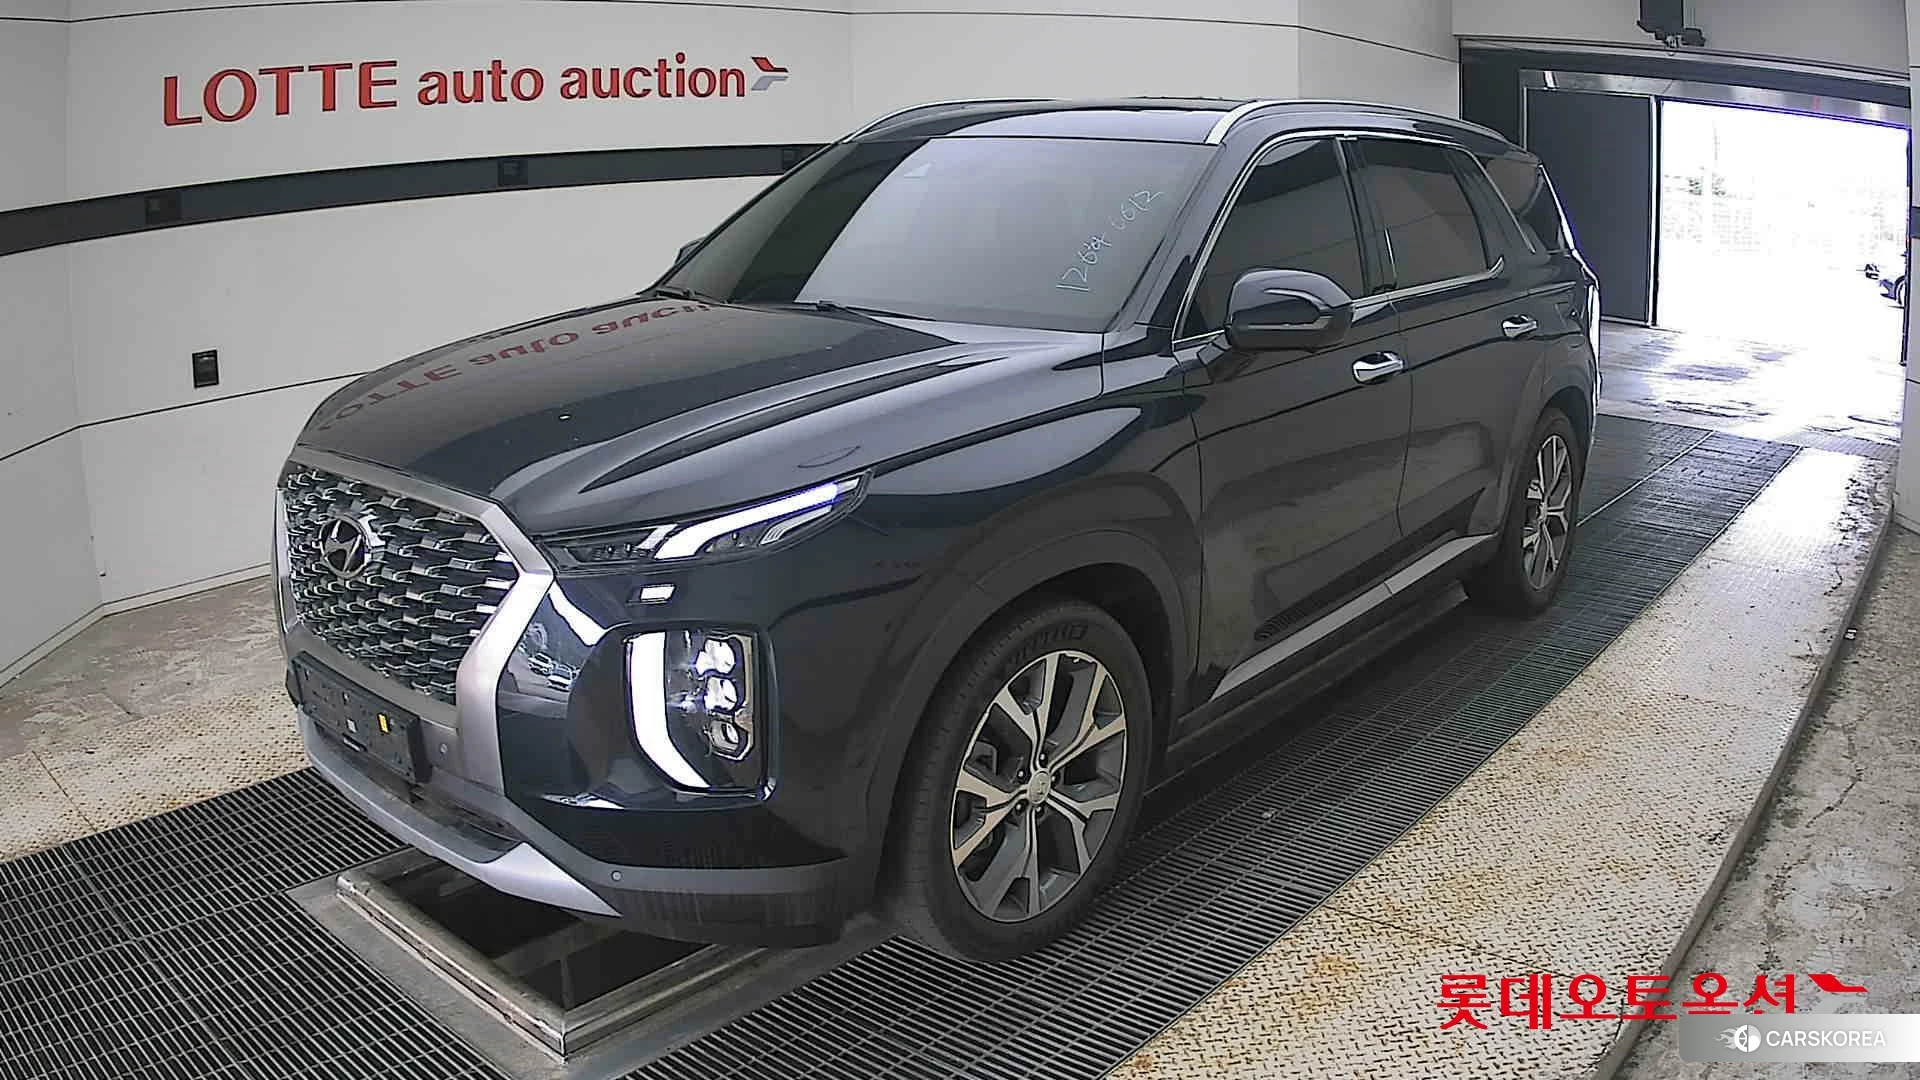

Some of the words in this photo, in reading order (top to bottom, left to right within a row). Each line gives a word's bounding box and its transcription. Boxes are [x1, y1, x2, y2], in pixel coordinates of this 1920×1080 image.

[162, 60, 398, 128] LOTTE
[417, 59, 545, 106] auto
[560, 51, 747, 99] auction
